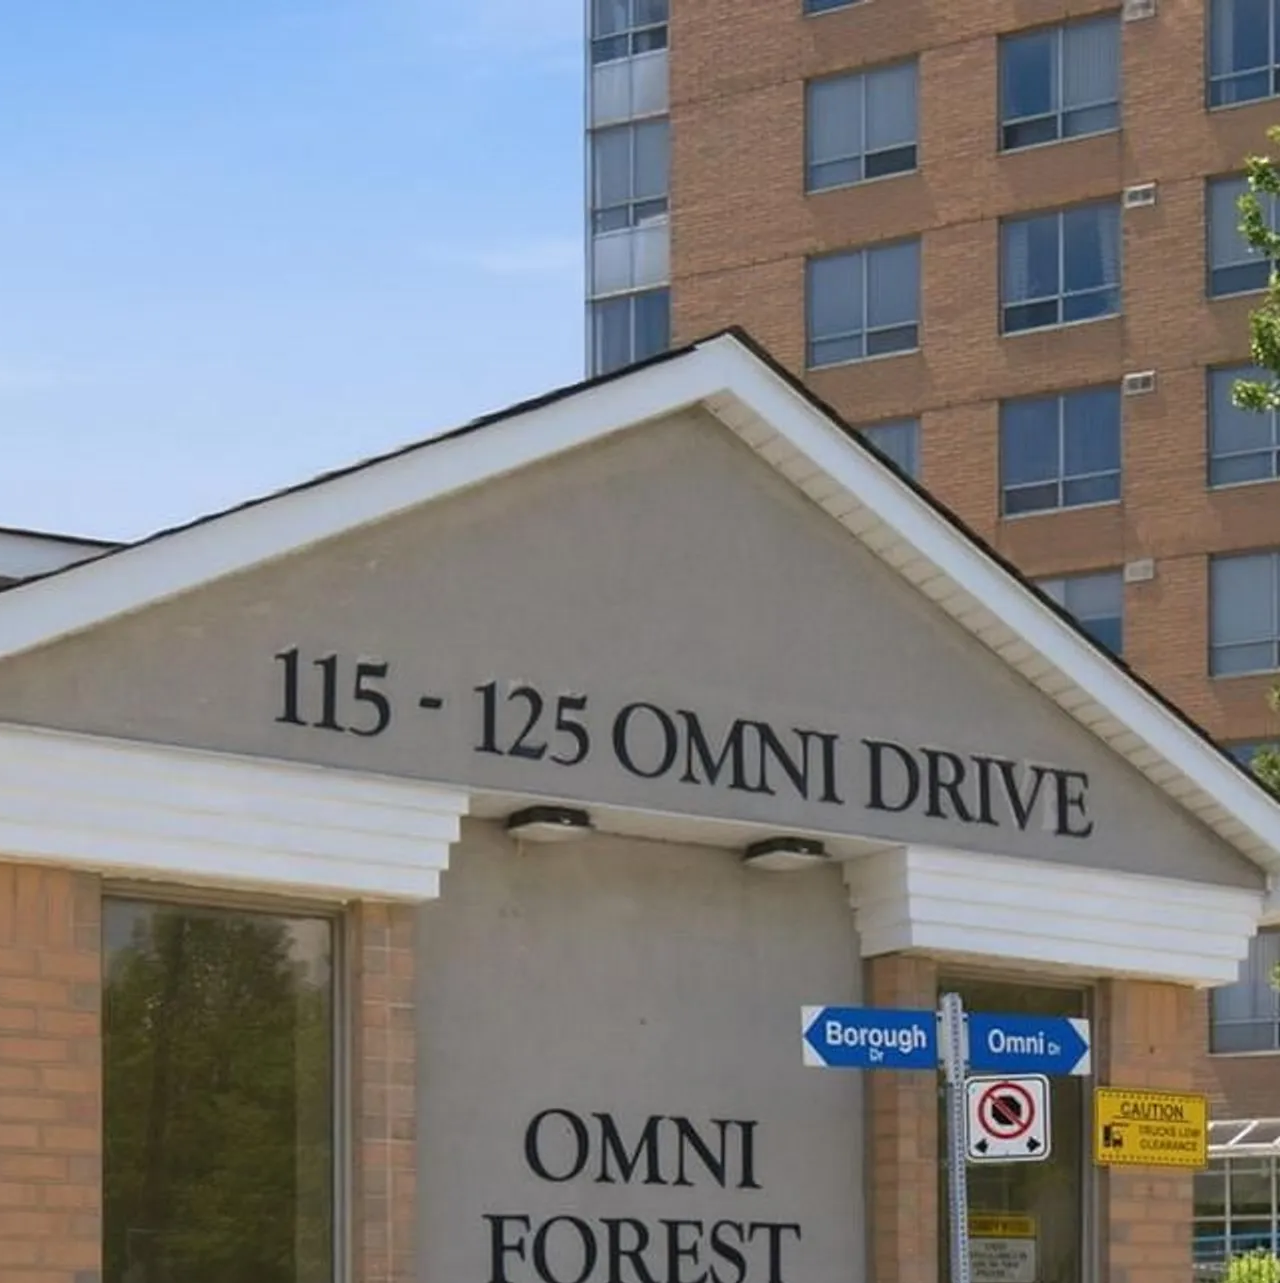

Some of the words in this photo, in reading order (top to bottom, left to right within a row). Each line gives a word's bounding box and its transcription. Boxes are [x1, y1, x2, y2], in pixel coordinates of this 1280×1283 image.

[275, 646, 393, 739] 115
[418, 696, 444, 711] -
[473, 680, 591, 767] 125
[611, 701, 845, 804] OMNI
[863, 738, 1096, 839] DRIVE
[825, 1020, 928, 1054] Borough
[987, 1028, 1045, 1056] Omni
[1048, 1042, 1061, 1055] Dr
[869, 1048, 884, 1062] Dr
[1120, 1101, 1184, 1120] CAUTION
[524, 1108, 763, 1189] OMNI
[1139, 1138, 1198, 1151] CLEARANCE
